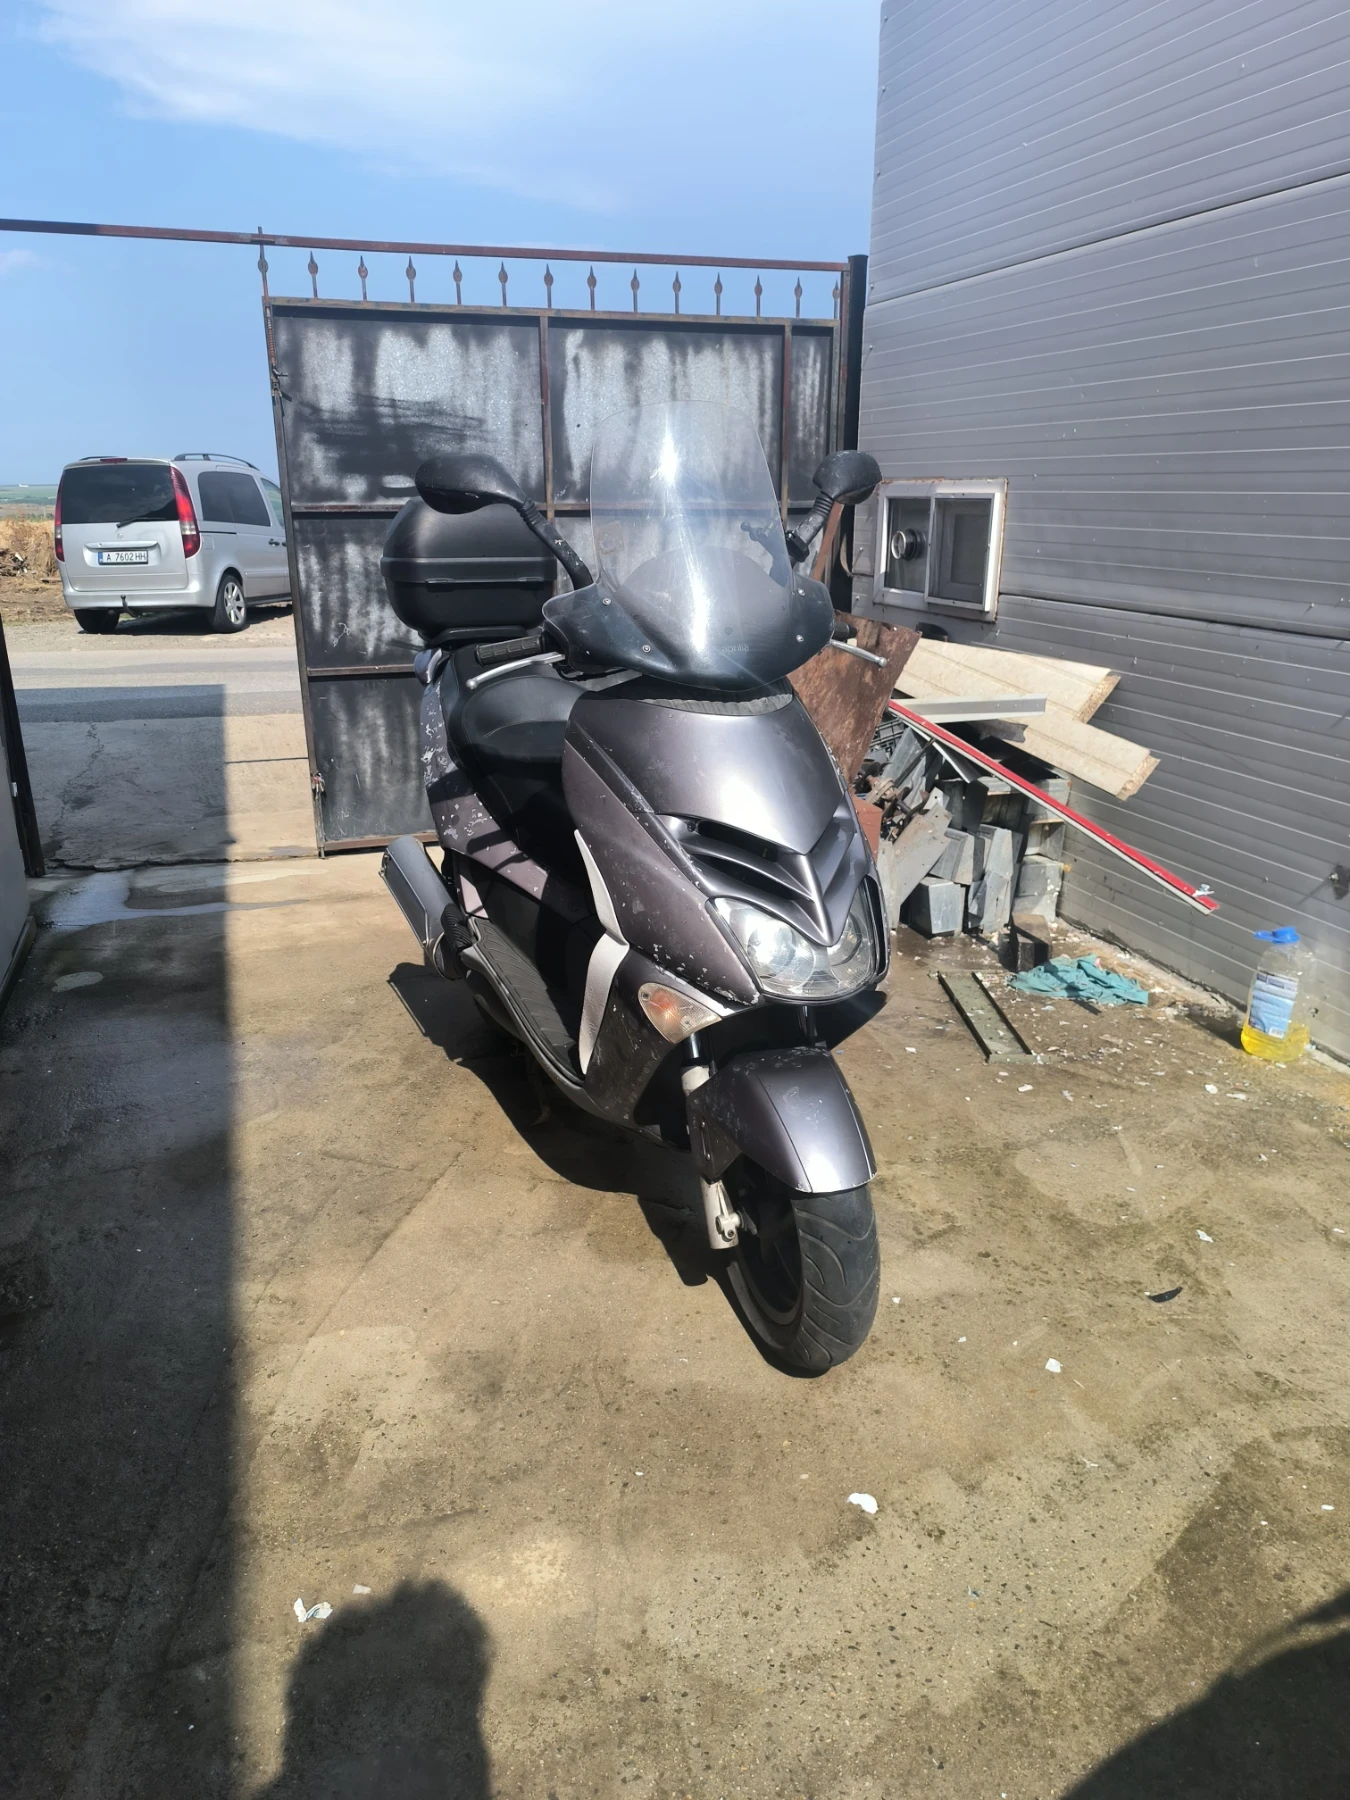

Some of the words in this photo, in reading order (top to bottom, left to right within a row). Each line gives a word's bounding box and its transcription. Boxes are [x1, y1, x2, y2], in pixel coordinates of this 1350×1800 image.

[106, 553, 111, 561] A
[115, 553, 134, 561] 7602
[721, 643, 749, 654] aprilia
